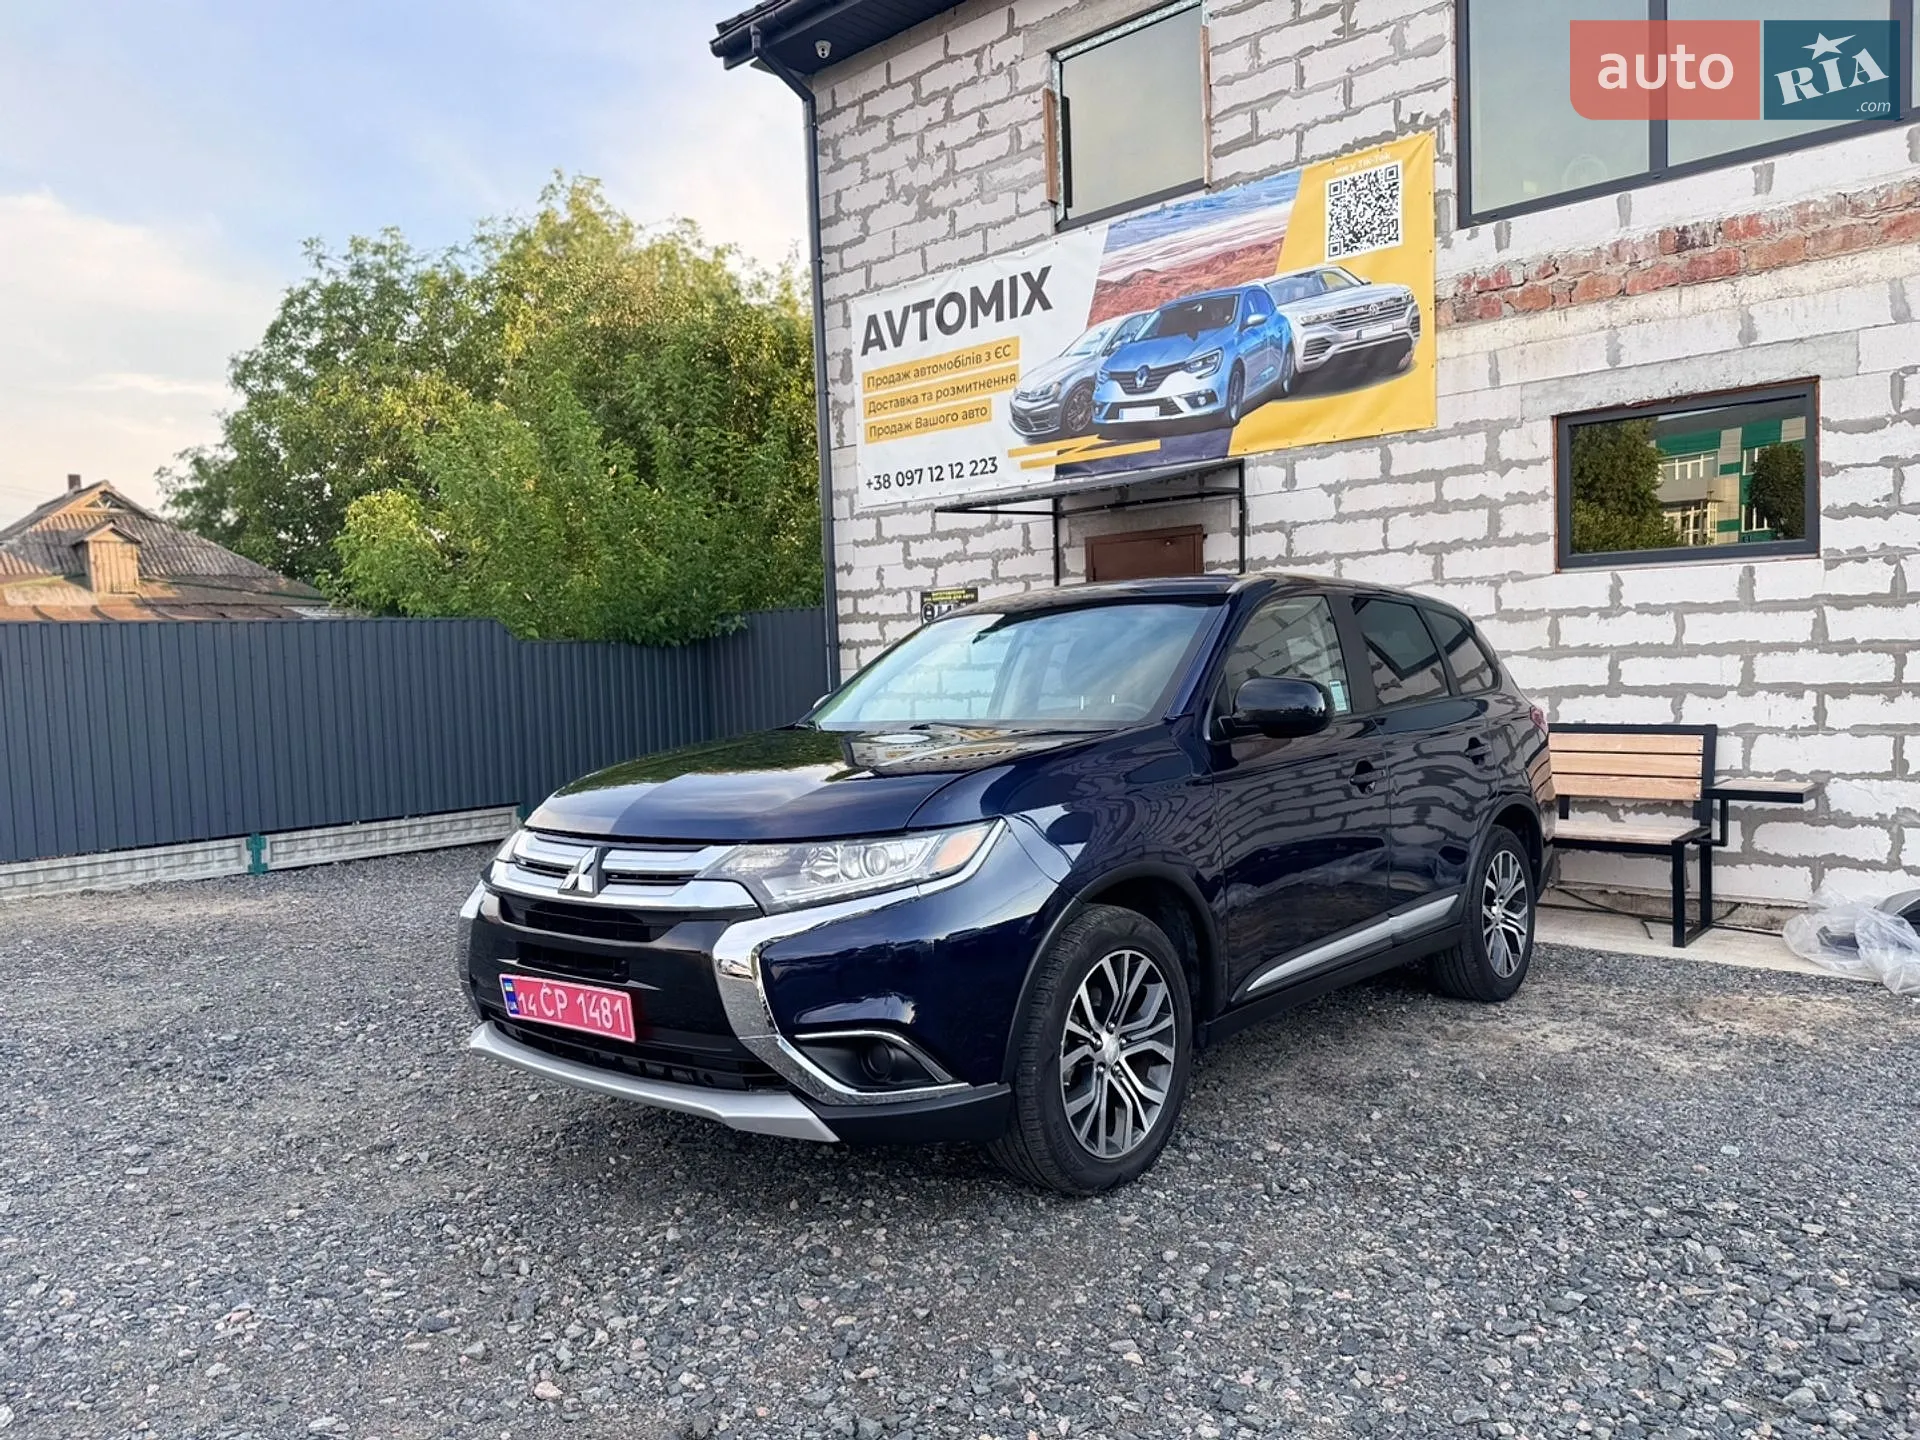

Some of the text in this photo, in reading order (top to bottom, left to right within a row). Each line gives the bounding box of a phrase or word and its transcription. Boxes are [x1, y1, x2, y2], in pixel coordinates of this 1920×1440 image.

[861, 265, 1052, 356] AVTOMIX
[866, 344, 1012, 389] Продаж автомобілів з ЄС
[868, 373, 1017, 415] Доставка та розмитнення
[869, 406, 988, 438] Продаж Вашого авто
[866, 456, 998, 491] +38 097 12 12 223
[518, 991, 538, 1017] 14
[576, 992, 626, 1033] 1481
